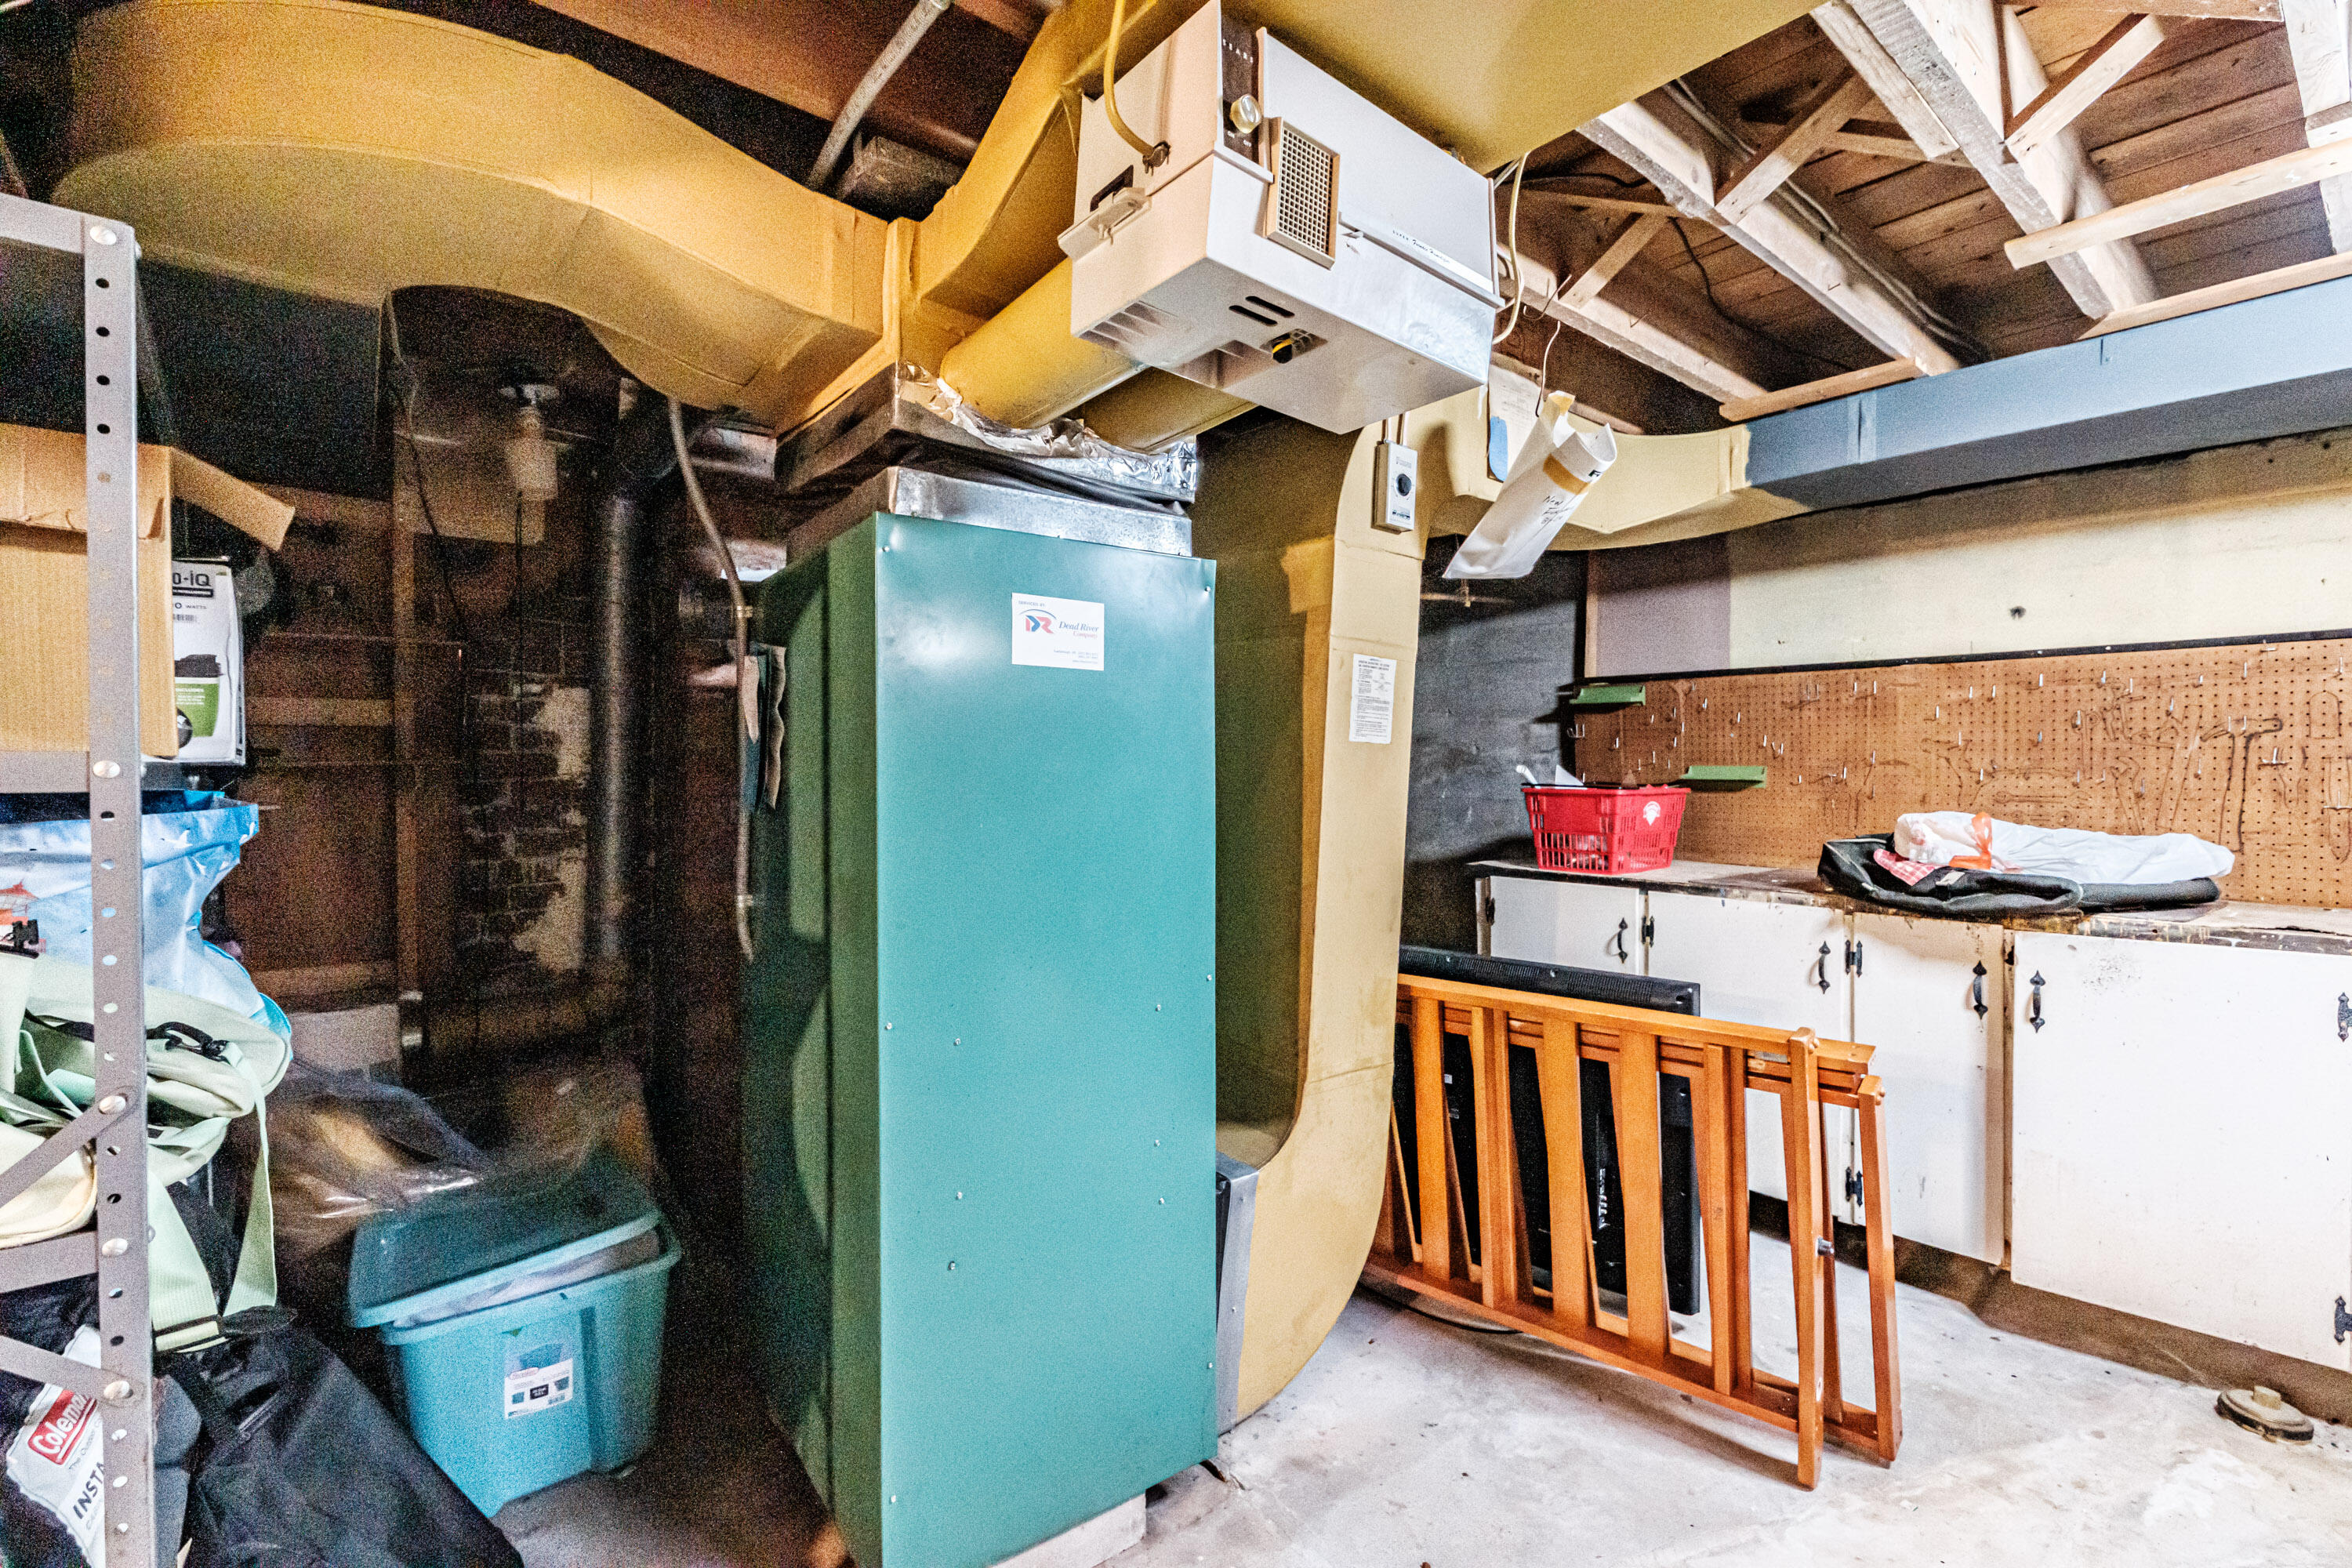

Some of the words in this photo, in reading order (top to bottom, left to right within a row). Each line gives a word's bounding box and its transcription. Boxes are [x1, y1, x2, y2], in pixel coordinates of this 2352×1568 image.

[1222, 38, 1254, 64] SEARS
[1058, 621, 1080, 630] Dead
[1080, 623, 1099, 633] River
